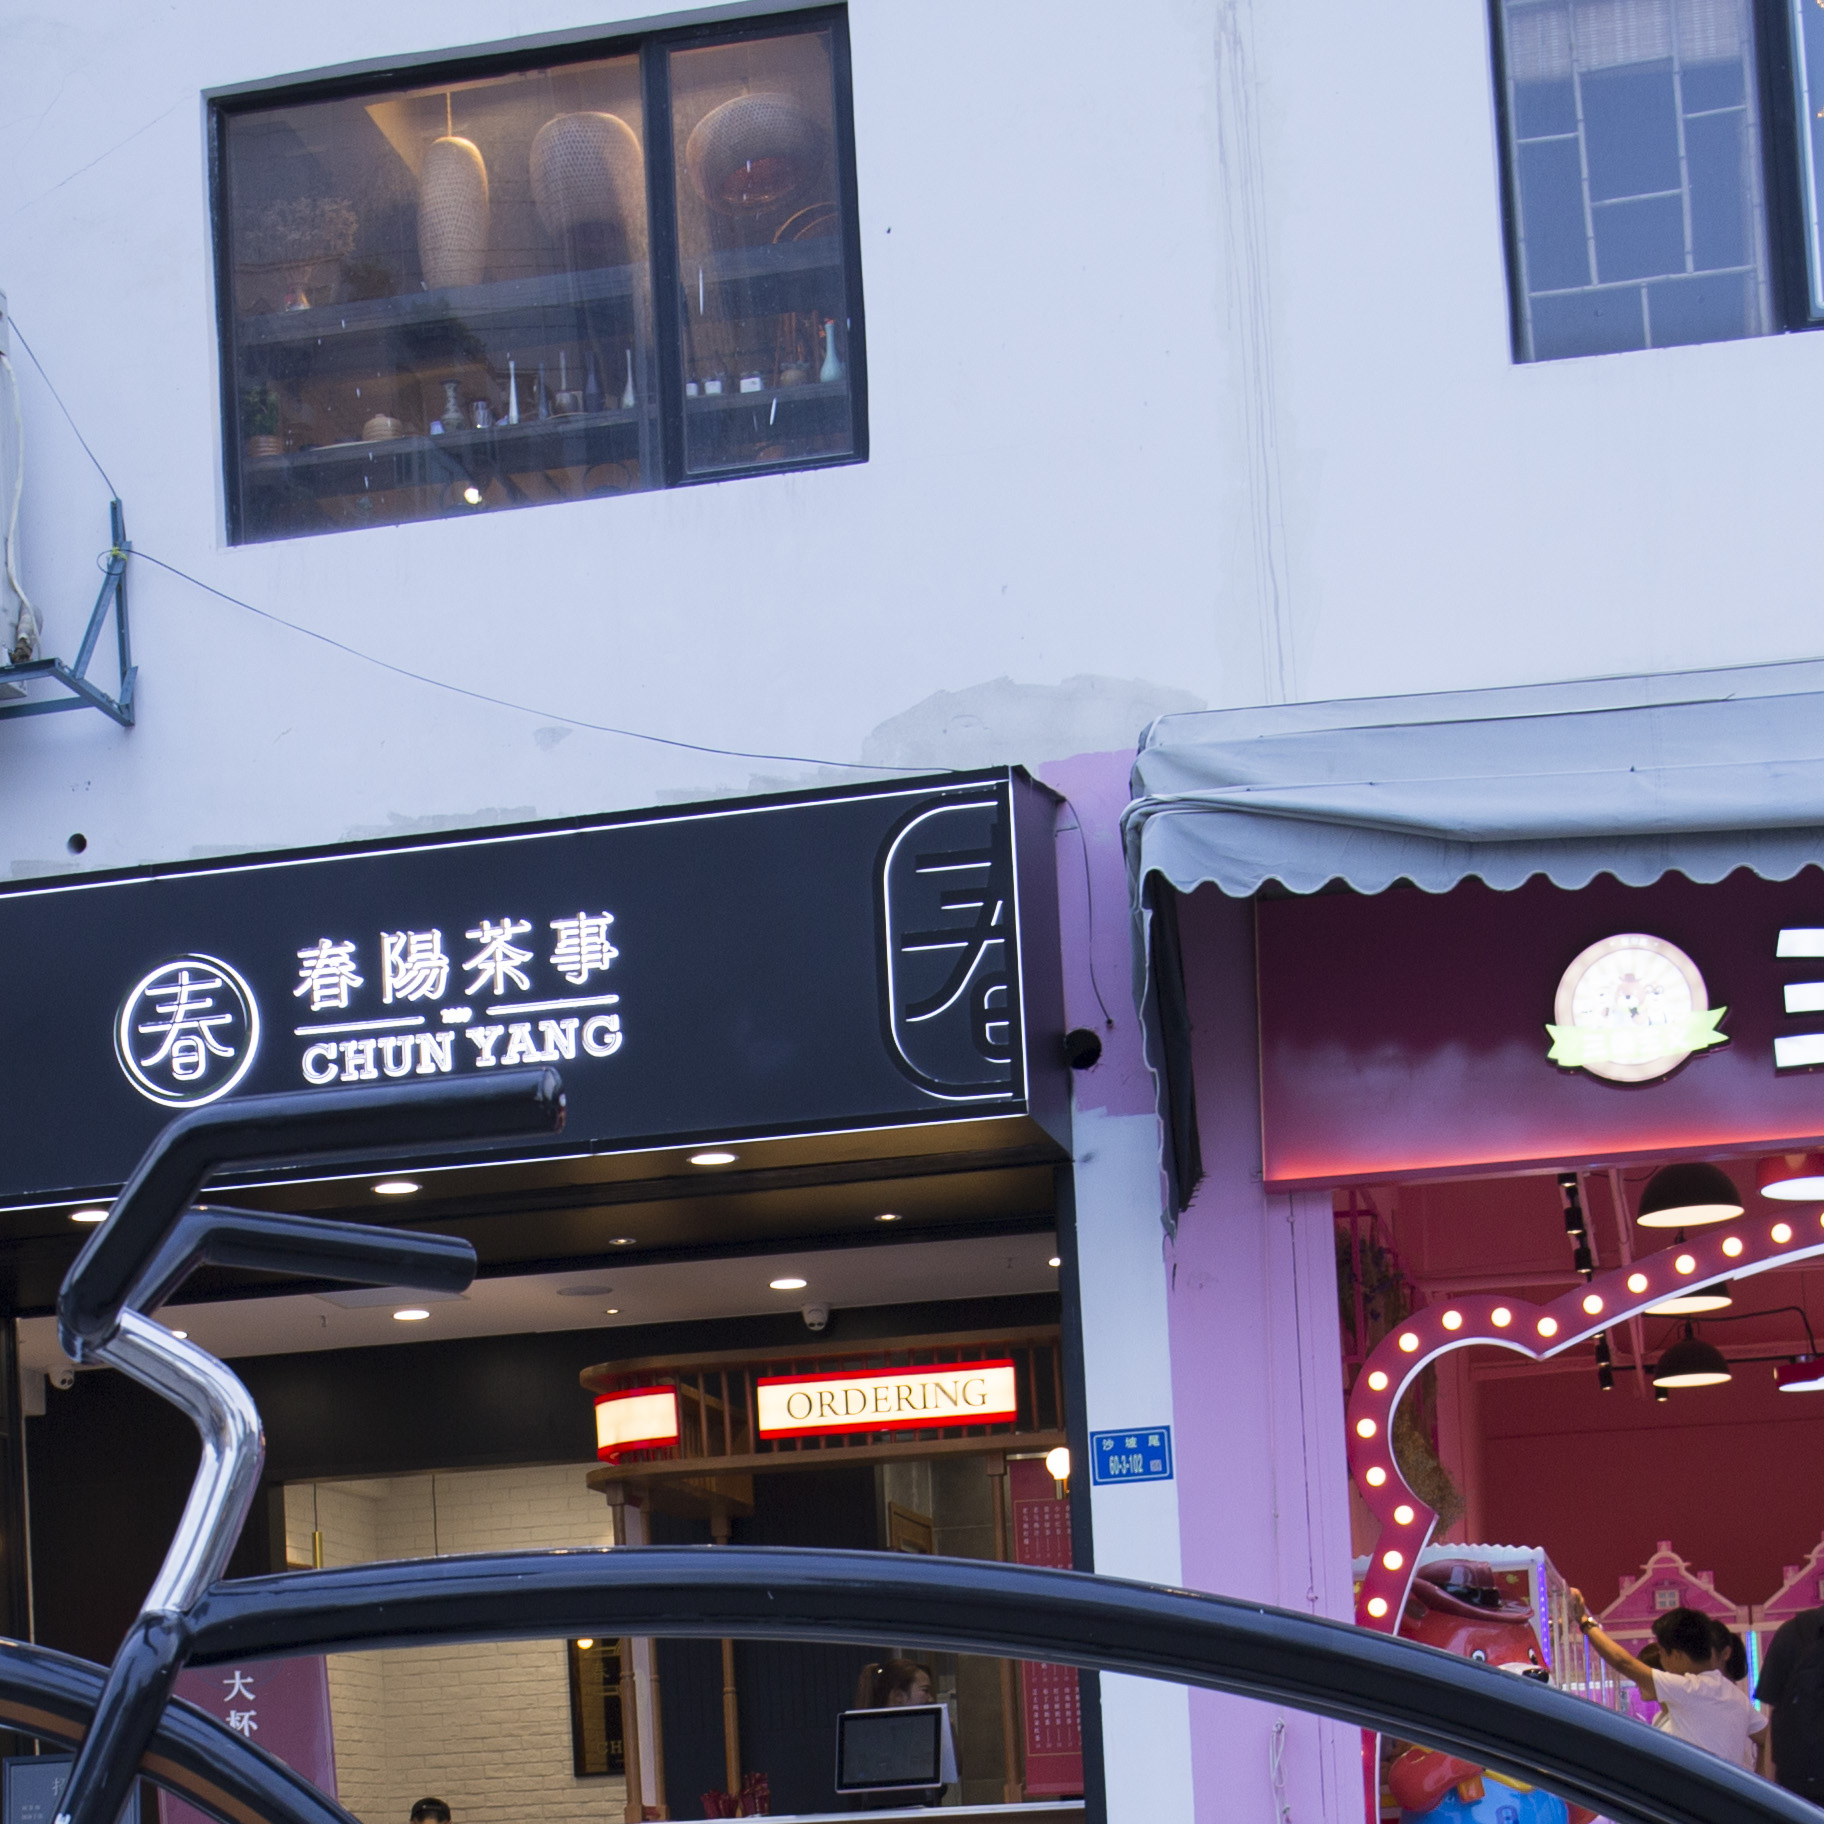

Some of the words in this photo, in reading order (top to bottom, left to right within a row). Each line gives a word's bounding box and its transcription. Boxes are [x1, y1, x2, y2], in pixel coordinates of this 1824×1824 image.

[293, 911, 620, 1012] 春陽茶事
[139, 970, 236, 1082] 春
[302, 1030, 456, 1085] CHUN
[467, 1013, 624, 1068] YANG
[786, 1377, 988, 1420] ORDERING
[1109, 1453, 1144, 1475] 60-3-102
[222, 1670, 258, 1738] 大杯
